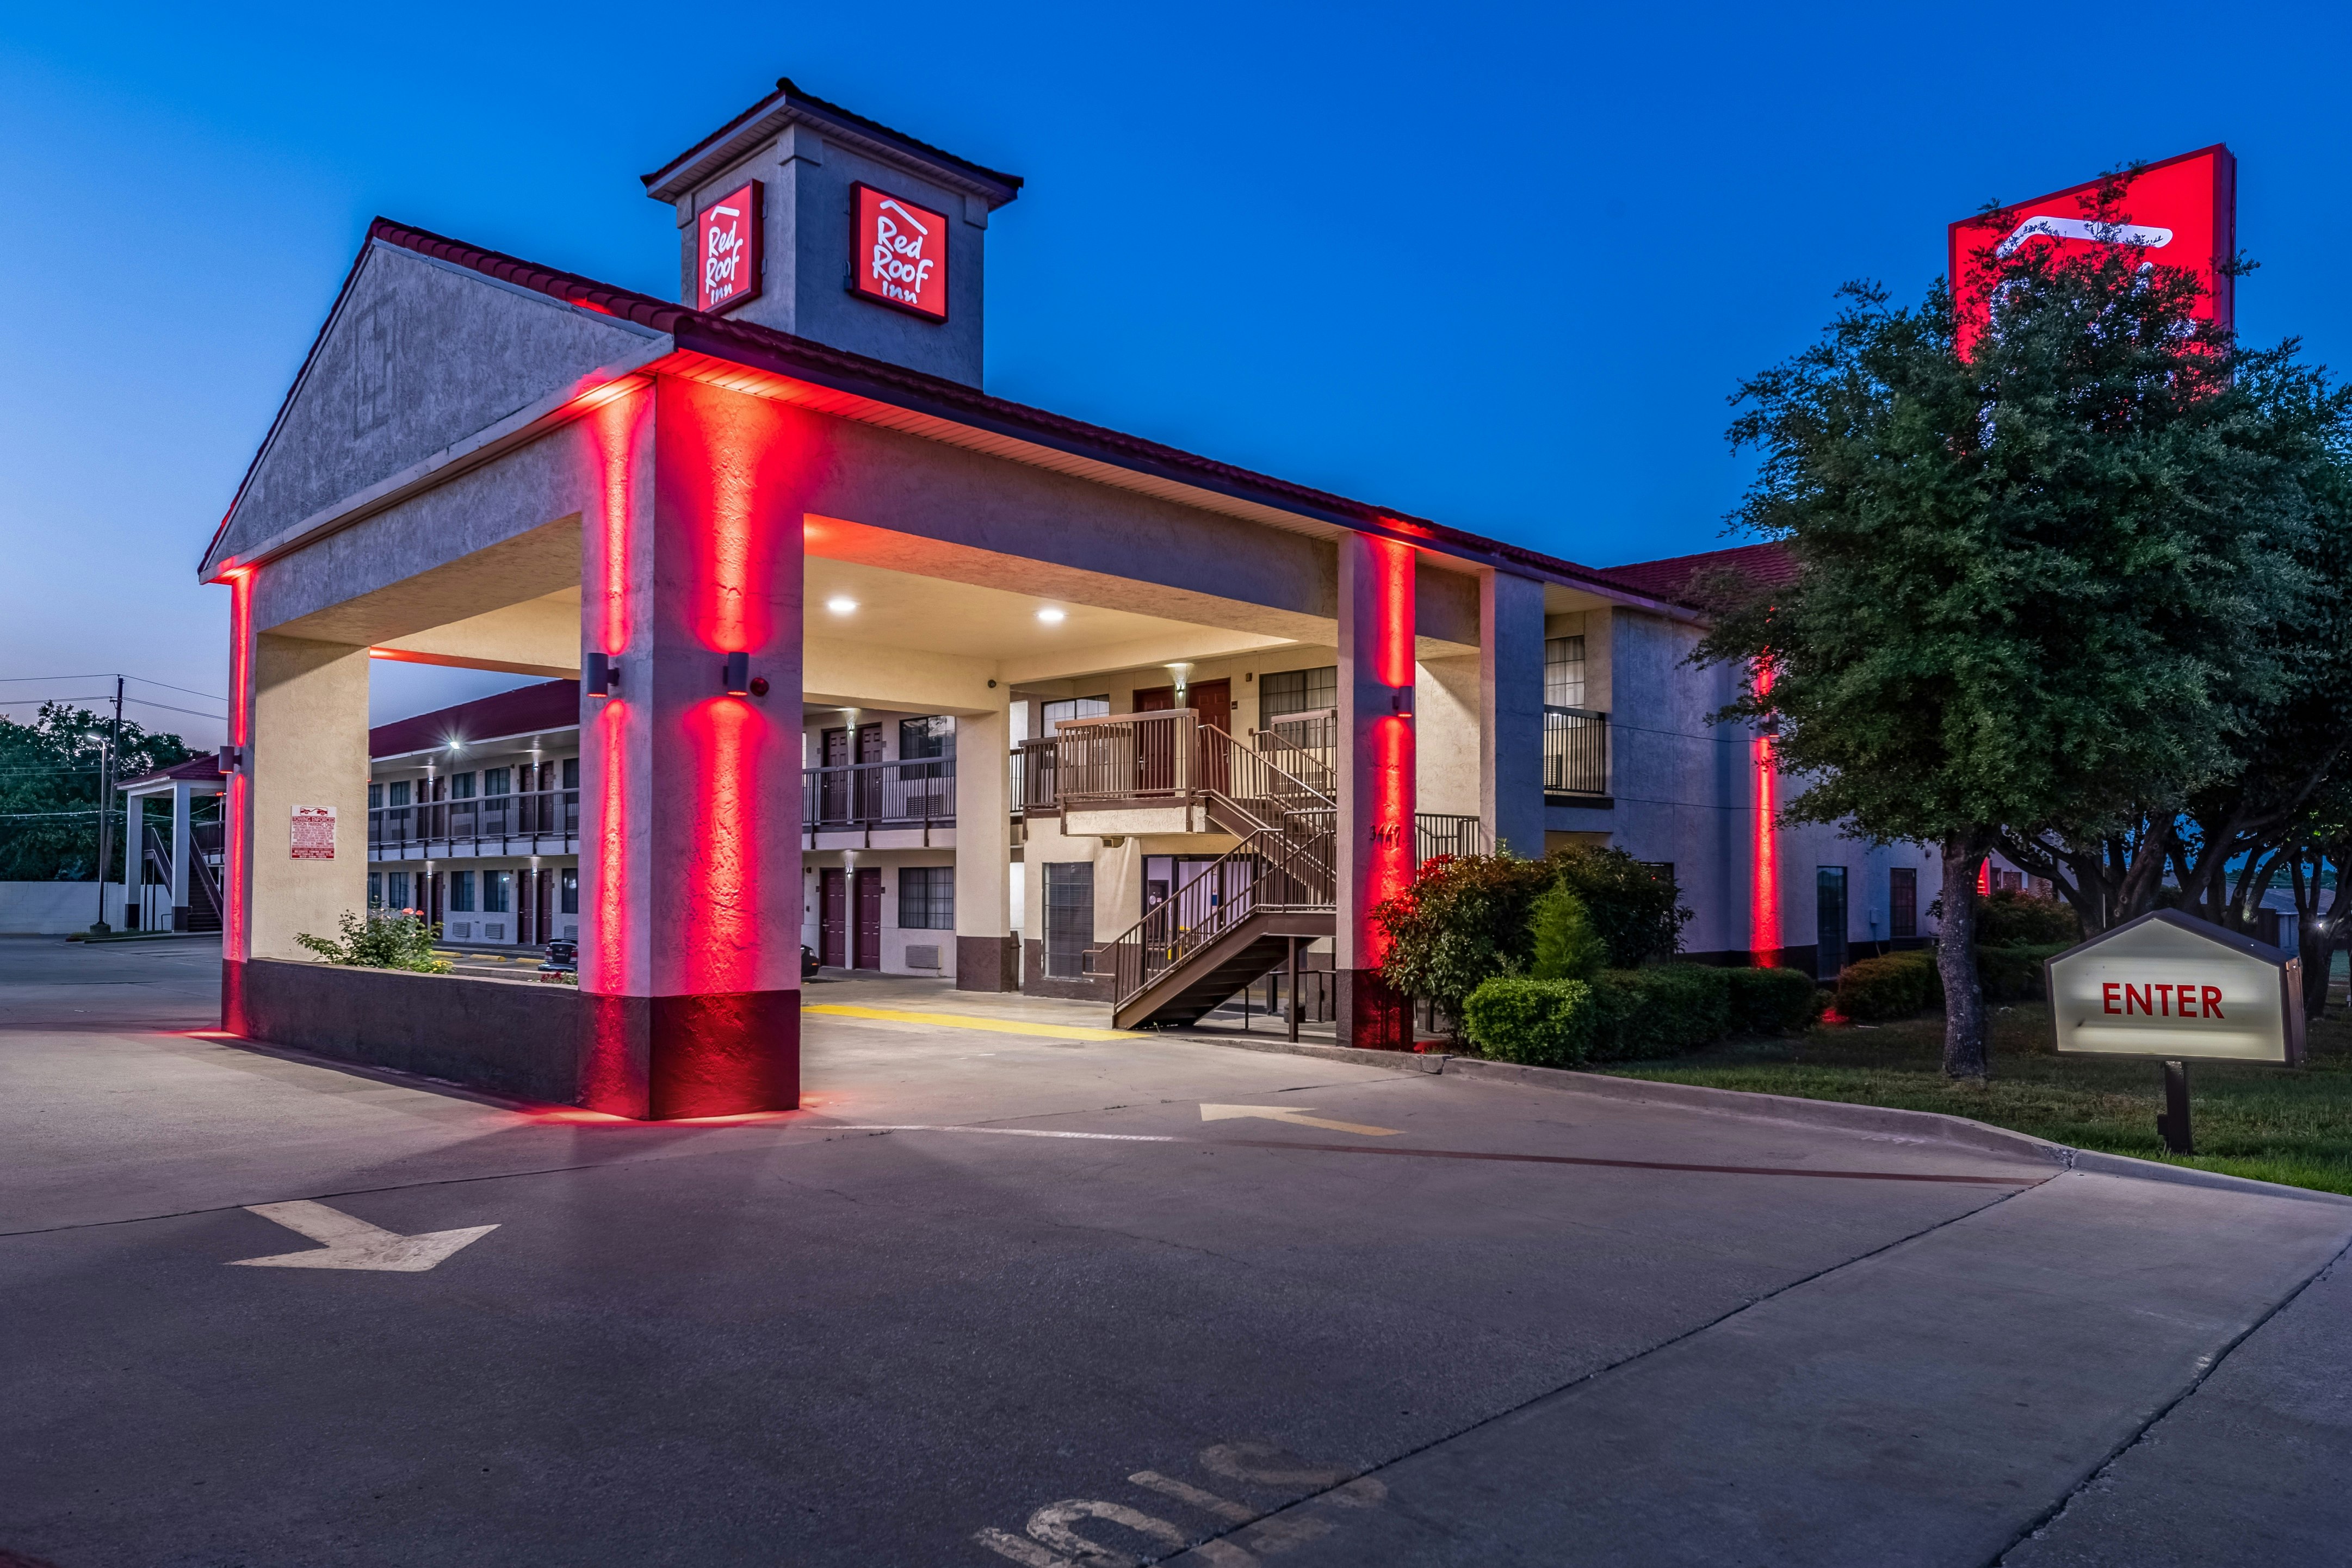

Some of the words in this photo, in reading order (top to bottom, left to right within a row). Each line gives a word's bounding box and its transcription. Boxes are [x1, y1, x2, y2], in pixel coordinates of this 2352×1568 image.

[709, 220, 737, 258] Red
[877, 216, 923, 259] Red
[705, 238, 744, 294] Roof
[872, 244, 934, 294] Roof
[2102, 982, 2225, 1019] ENTER
